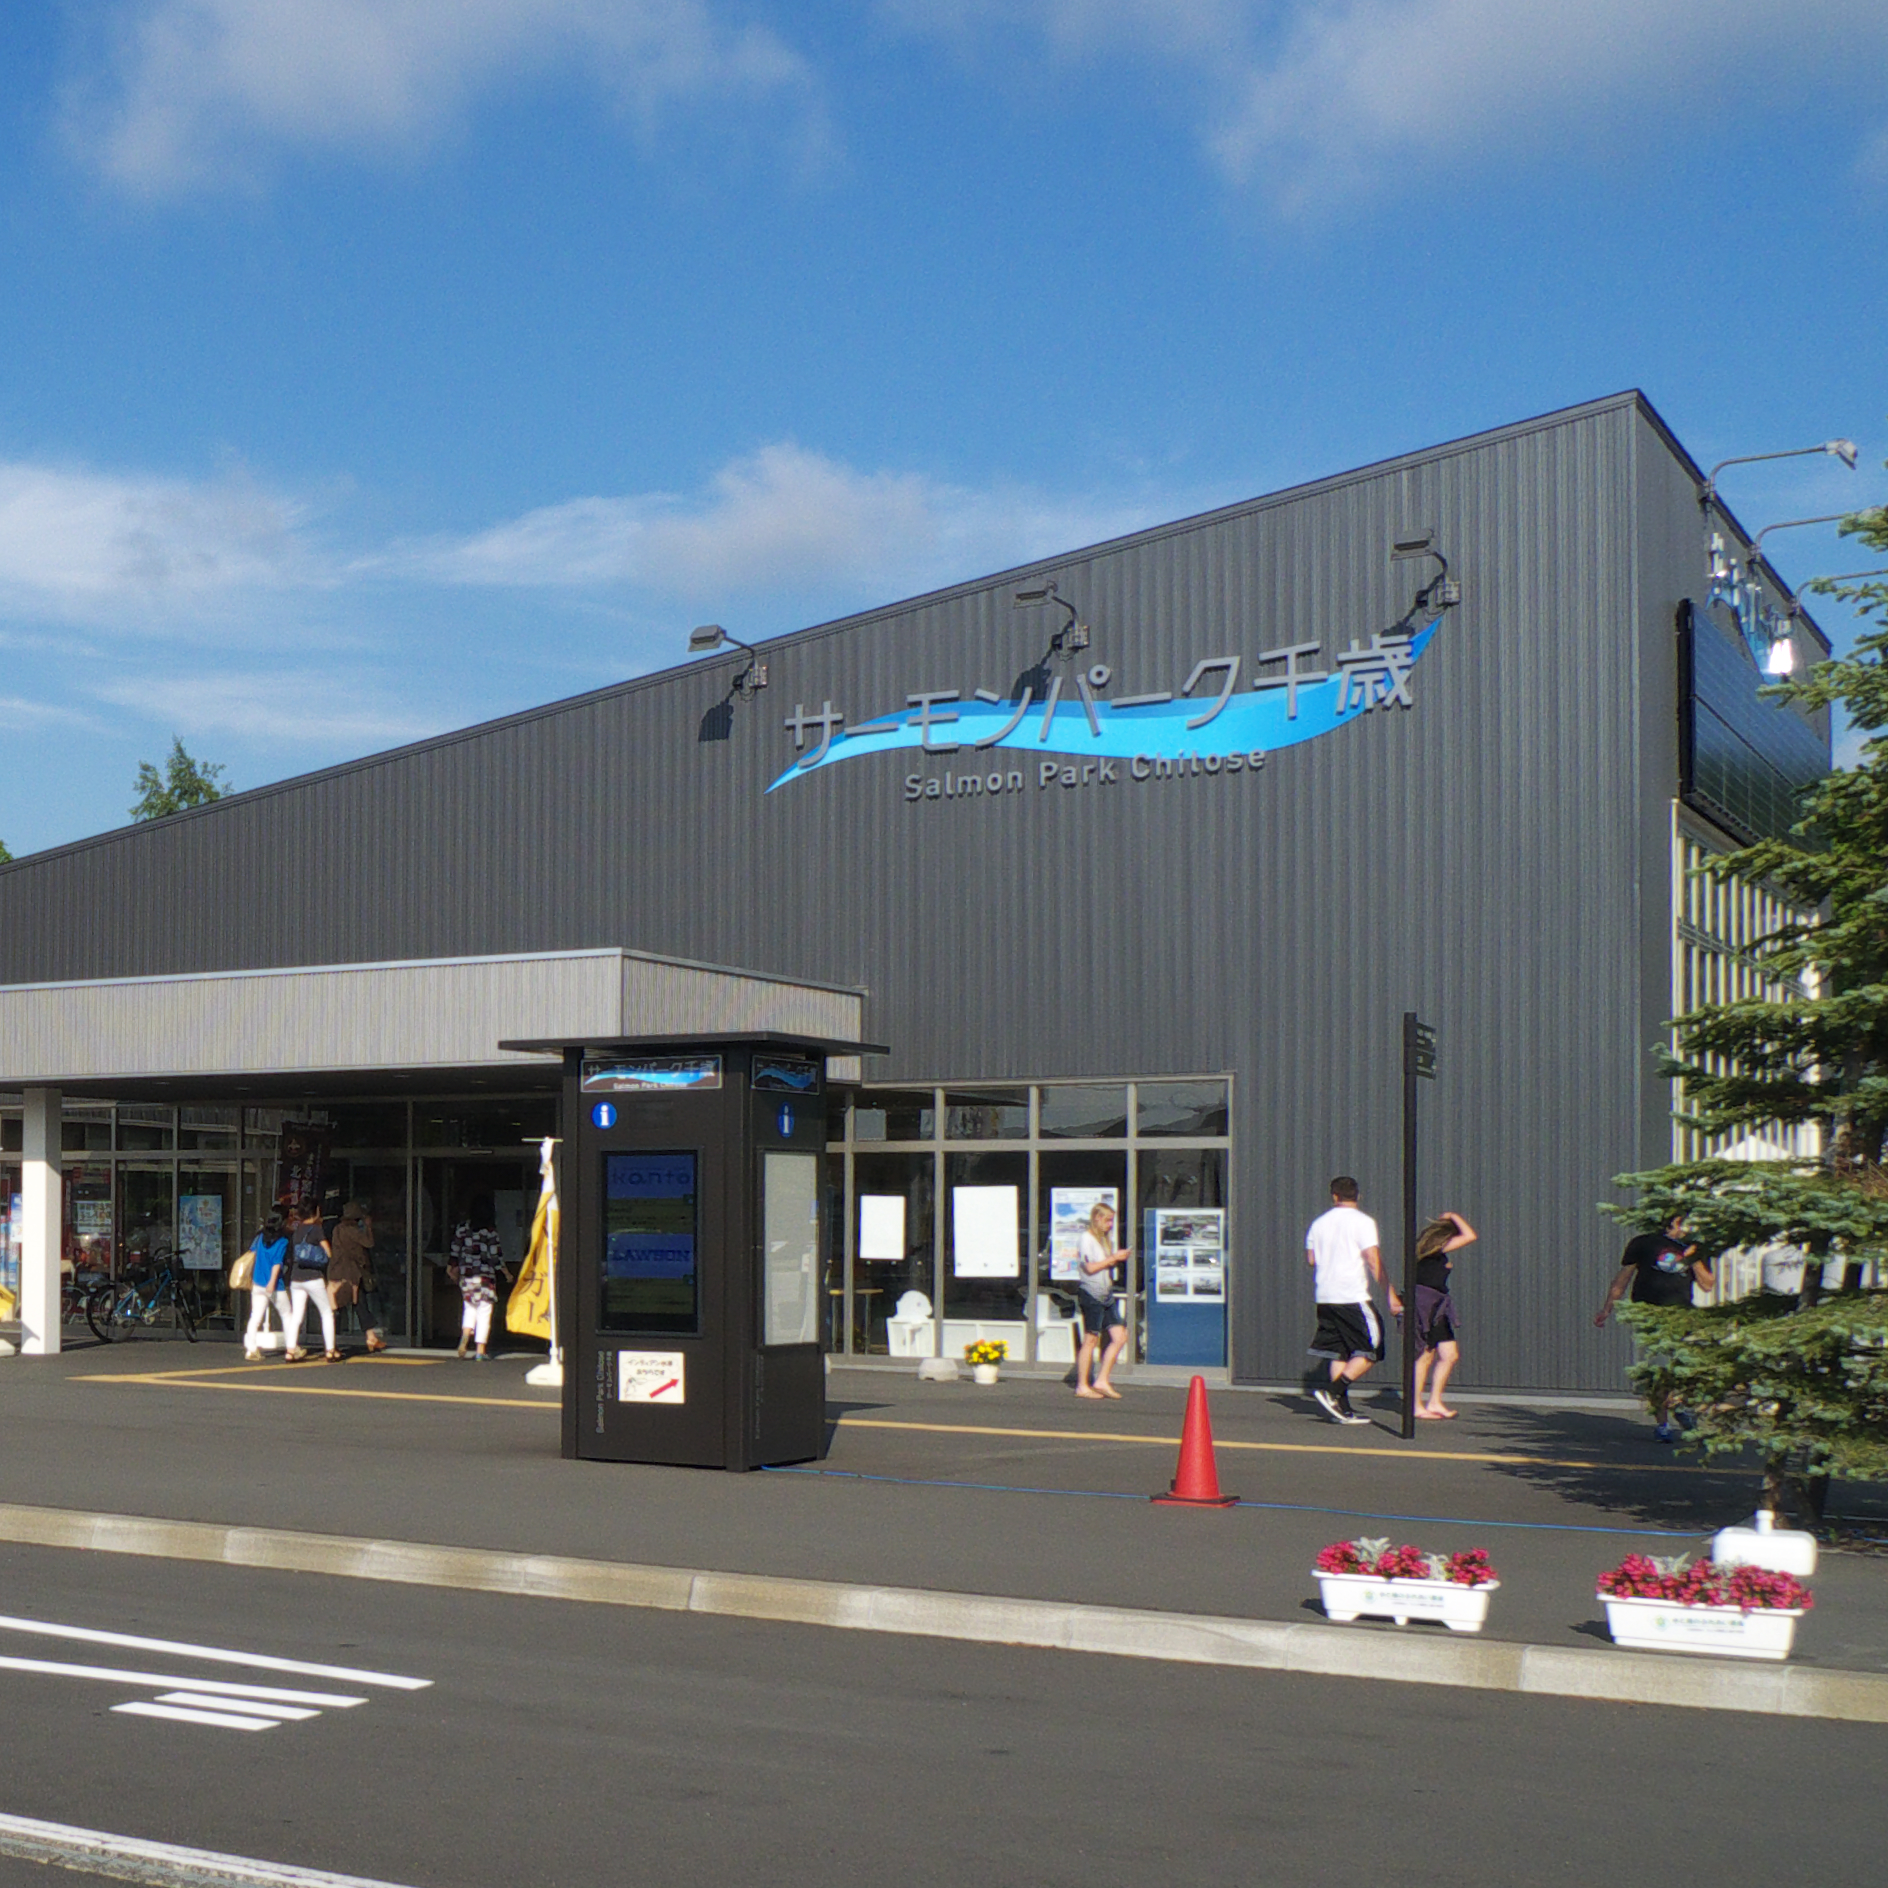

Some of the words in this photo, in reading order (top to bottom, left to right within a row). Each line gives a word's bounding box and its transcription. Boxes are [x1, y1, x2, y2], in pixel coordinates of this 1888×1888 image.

[784, 631, 1414, 770] サーモンパーク千歳
[905, 769, 1024, 801] Salmon
[1038, 756, 1117, 789] Park
[1130, 745, 1267, 781] Chitose
